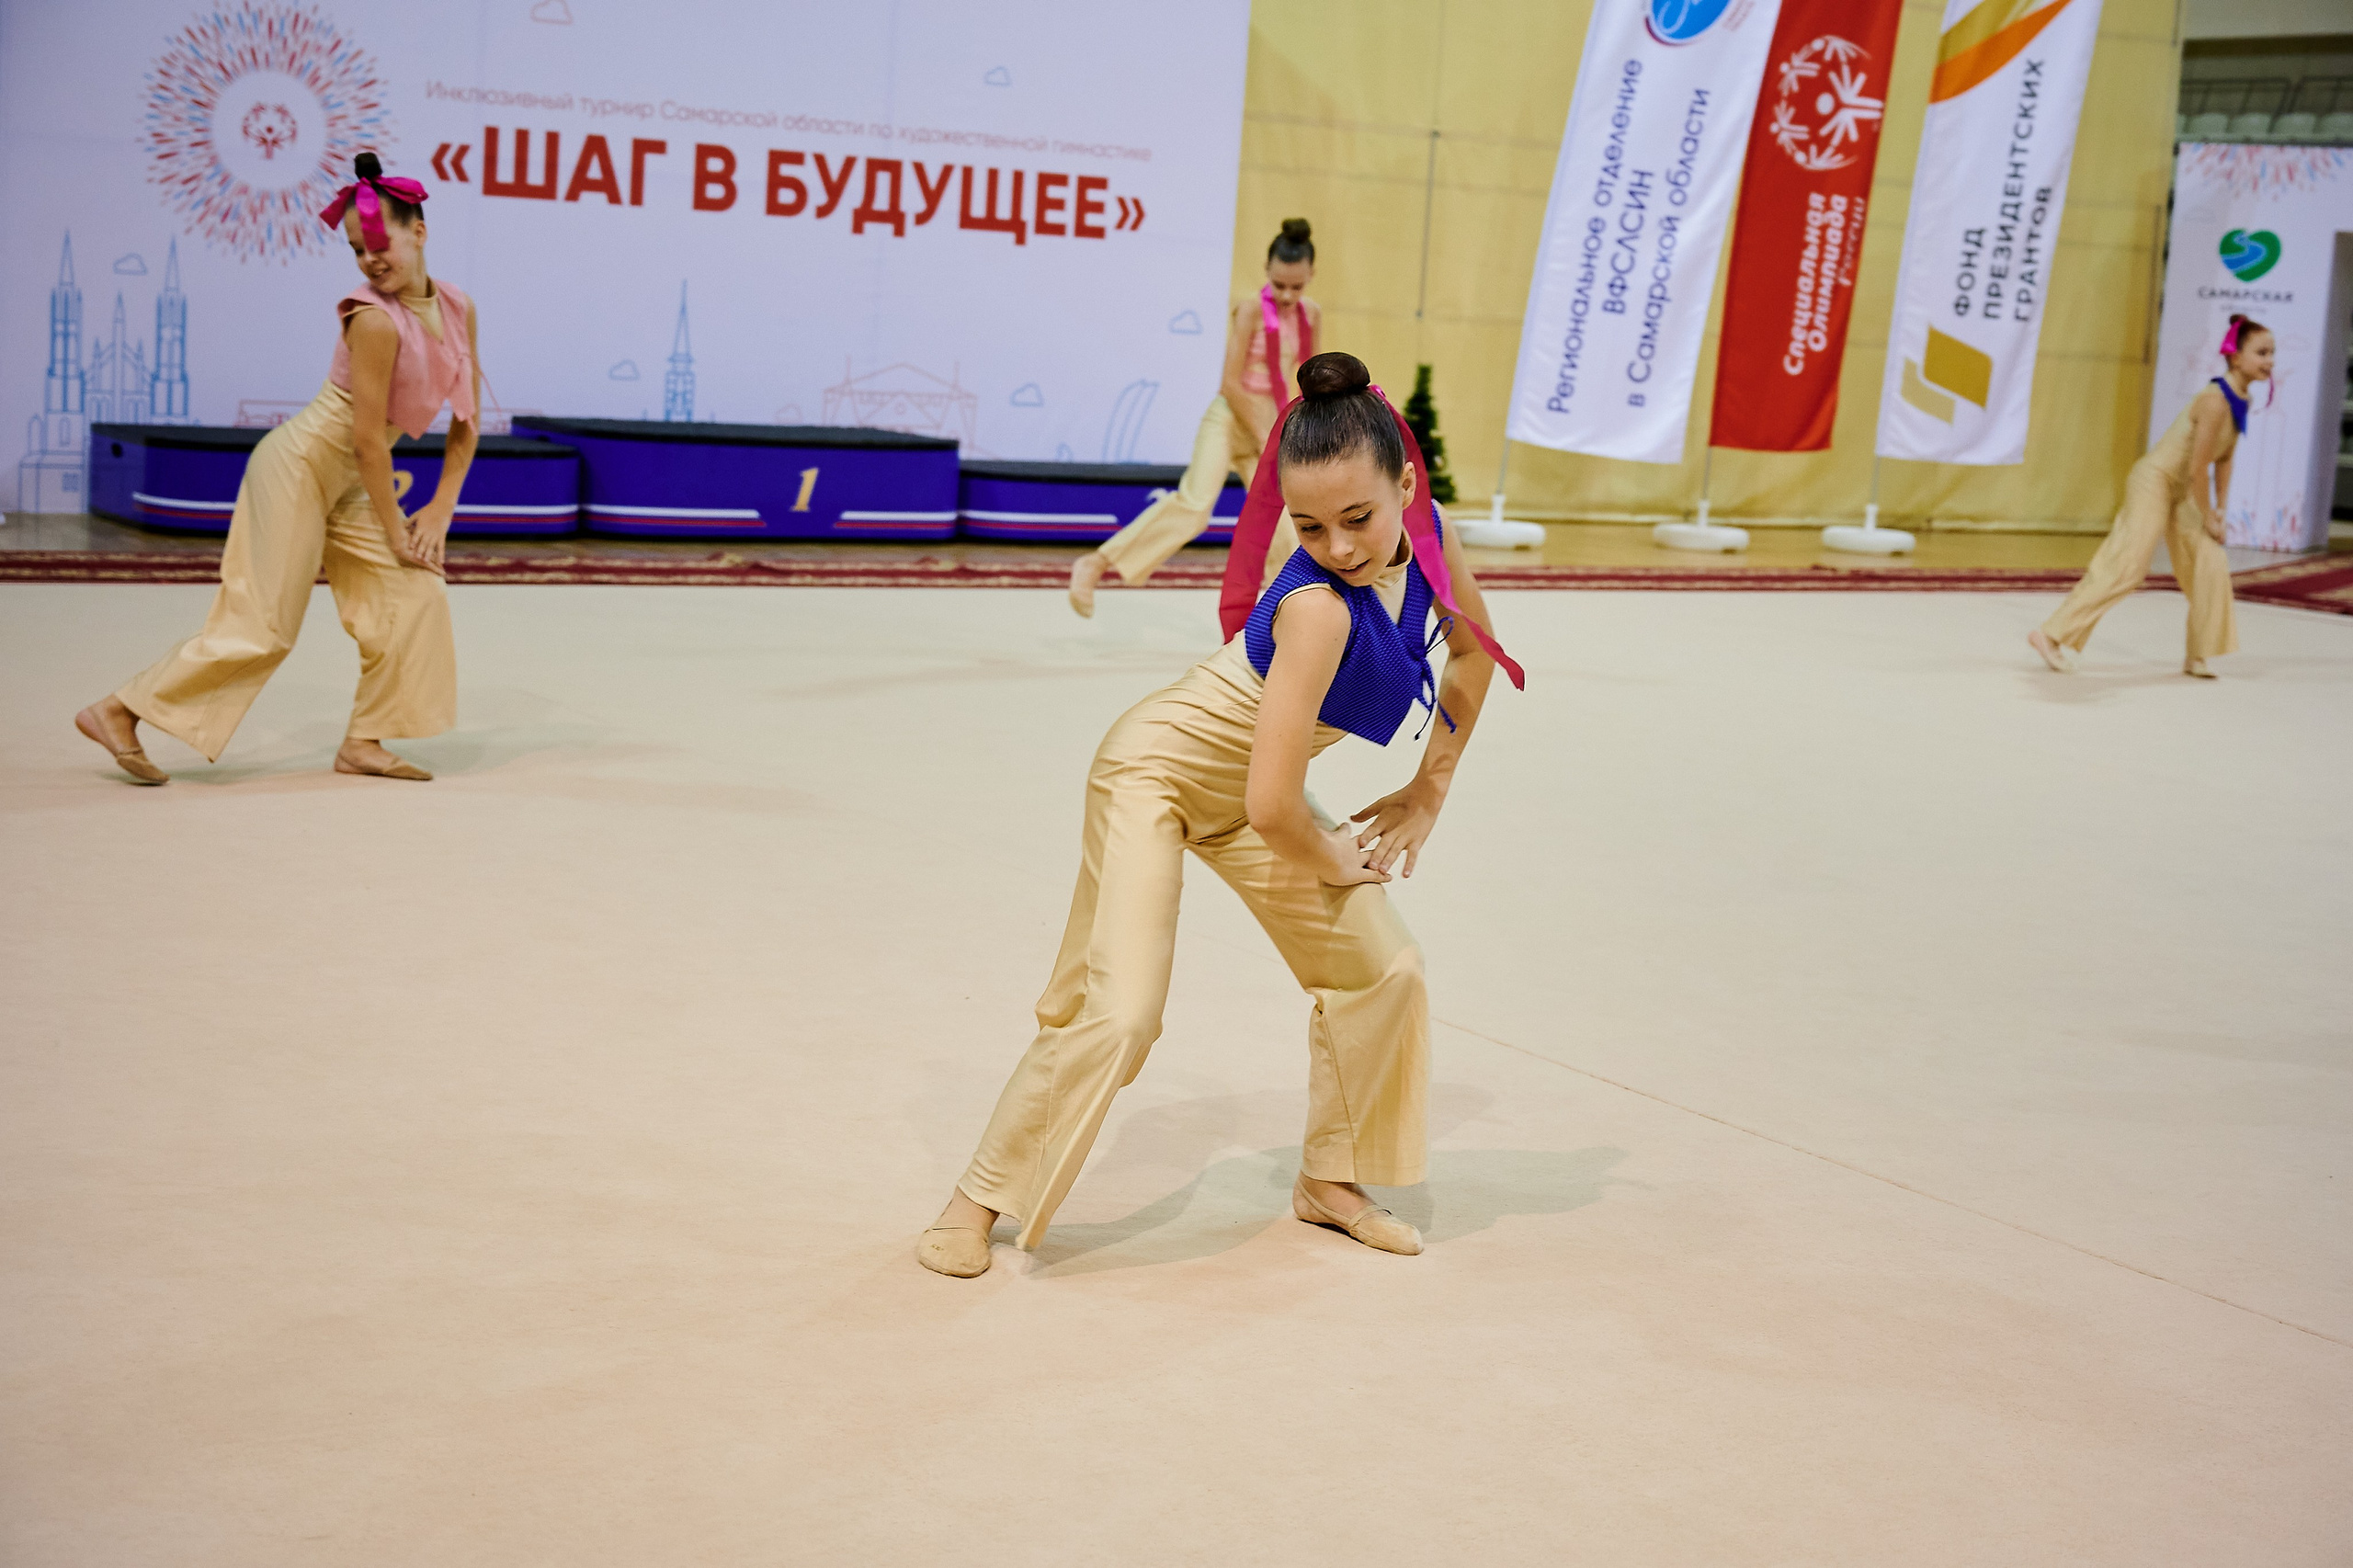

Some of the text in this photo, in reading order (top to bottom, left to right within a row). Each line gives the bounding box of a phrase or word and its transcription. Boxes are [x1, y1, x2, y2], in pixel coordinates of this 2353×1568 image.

[430, 125, 1145, 245] «ШАГ В БУДУЩЕЕ»
[579, 96, 655, 119] турнир
[659, 99, 778, 129] Самарской
[782, 113, 865, 135] области
[869, 123, 893, 138] по
[1983, 58, 2045, 320] ПРЕЗИДЕНТСКИХ
[1546, 59, 1643, 414] Региональное отделение
[1601, 169, 1654, 314] ВФСЛСИН
[1626, 214, 1681, 383] Самарской
[1665, 88, 1711, 207] области
[1783, 192, 1825, 376] Специальная
[1807, 194, 1847, 352] Олимпиада
[1953, 228, 1986, 316] ФОНД
[2014, 186, 2052, 322] ГРАНТОВ
[790, 467, 820, 512] 1
